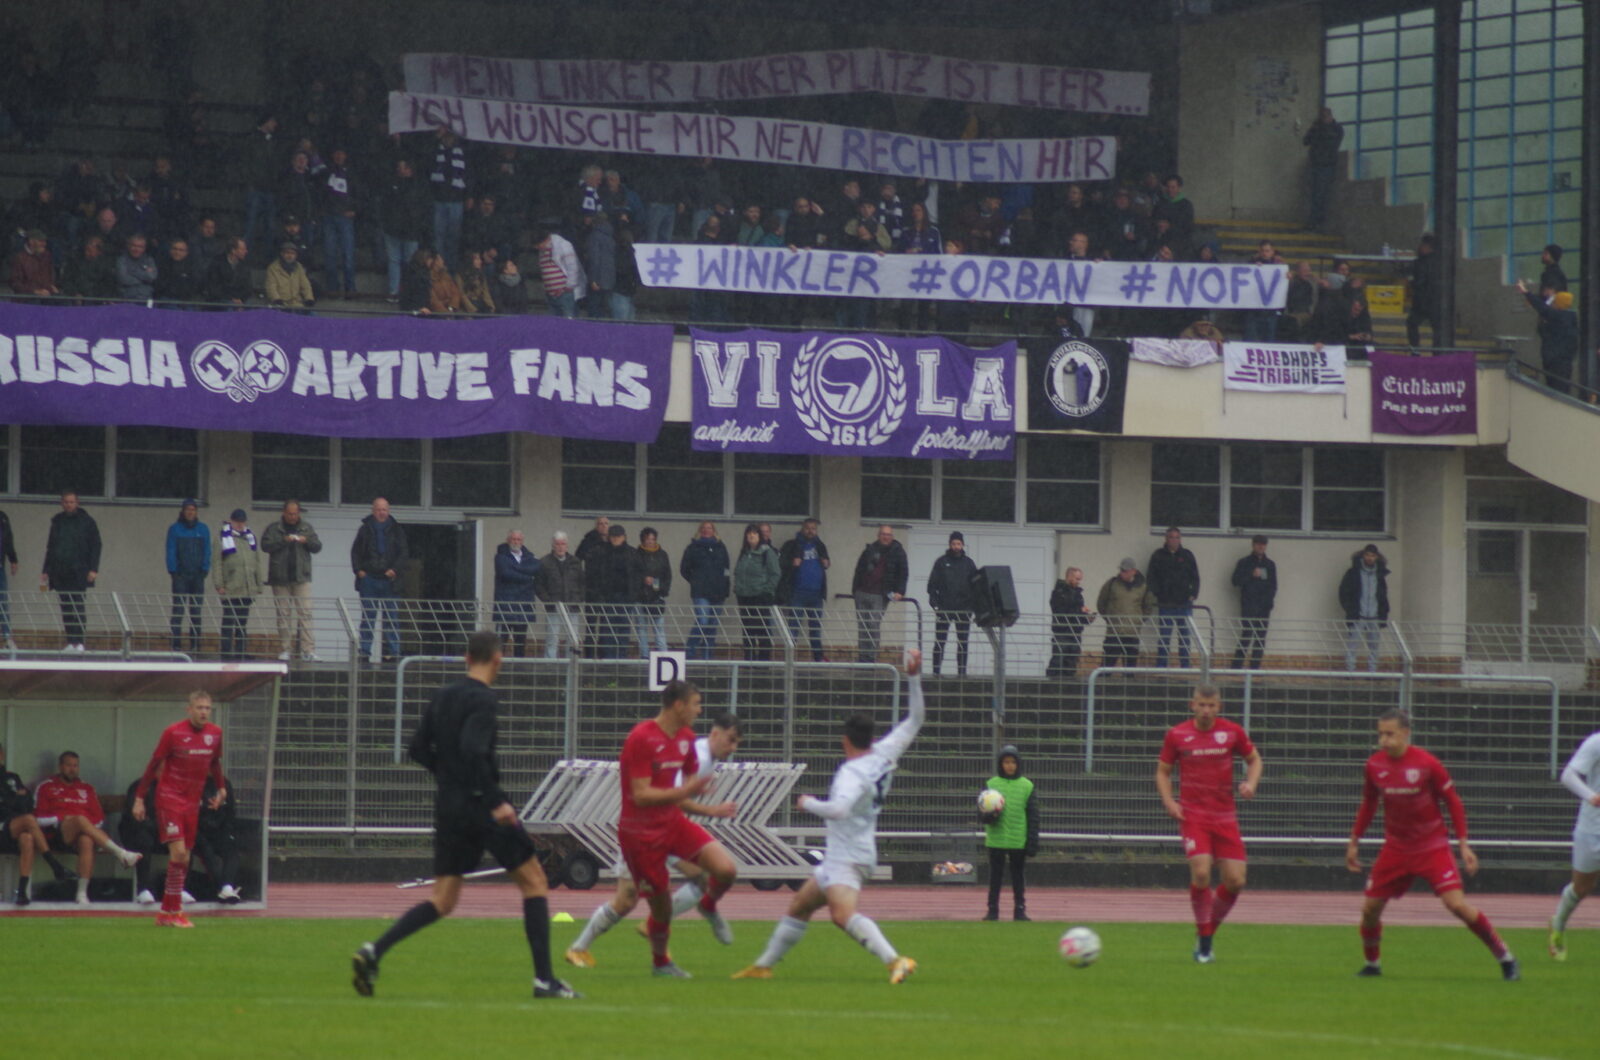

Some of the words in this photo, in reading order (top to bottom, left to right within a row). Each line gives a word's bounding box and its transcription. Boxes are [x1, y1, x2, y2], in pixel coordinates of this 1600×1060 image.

[431, 56, 515, 97] MEIN
[535, 60, 675, 100] LINKER
[693, 55, 816, 99] LINKER
[826, 51, 931, 94] PLATZ
[944, 53, 999, 101] IST
[409, 96, 468, 139] ICH
[482, 102, 657, 153] WÜNSCHE
[673, 114, 740, 157] MIR
[756, 119, 823, 164] NEN
[840, 127, 1024, 181] RECHTEN
[1245, 348, 1328, 368] FRIEDHOFS
[291, 347, 494, 401] AKTIVE
[509, 348, 652, 411] FANS
[1257, 367, 1319, 385] TRIBÜNE
[1382, 375, 1467, 399] Eichkamp
[693, 418, 780, 449] antifascist
[830, 425, 868, 446] 161
[656, 656, 679, 685] D
